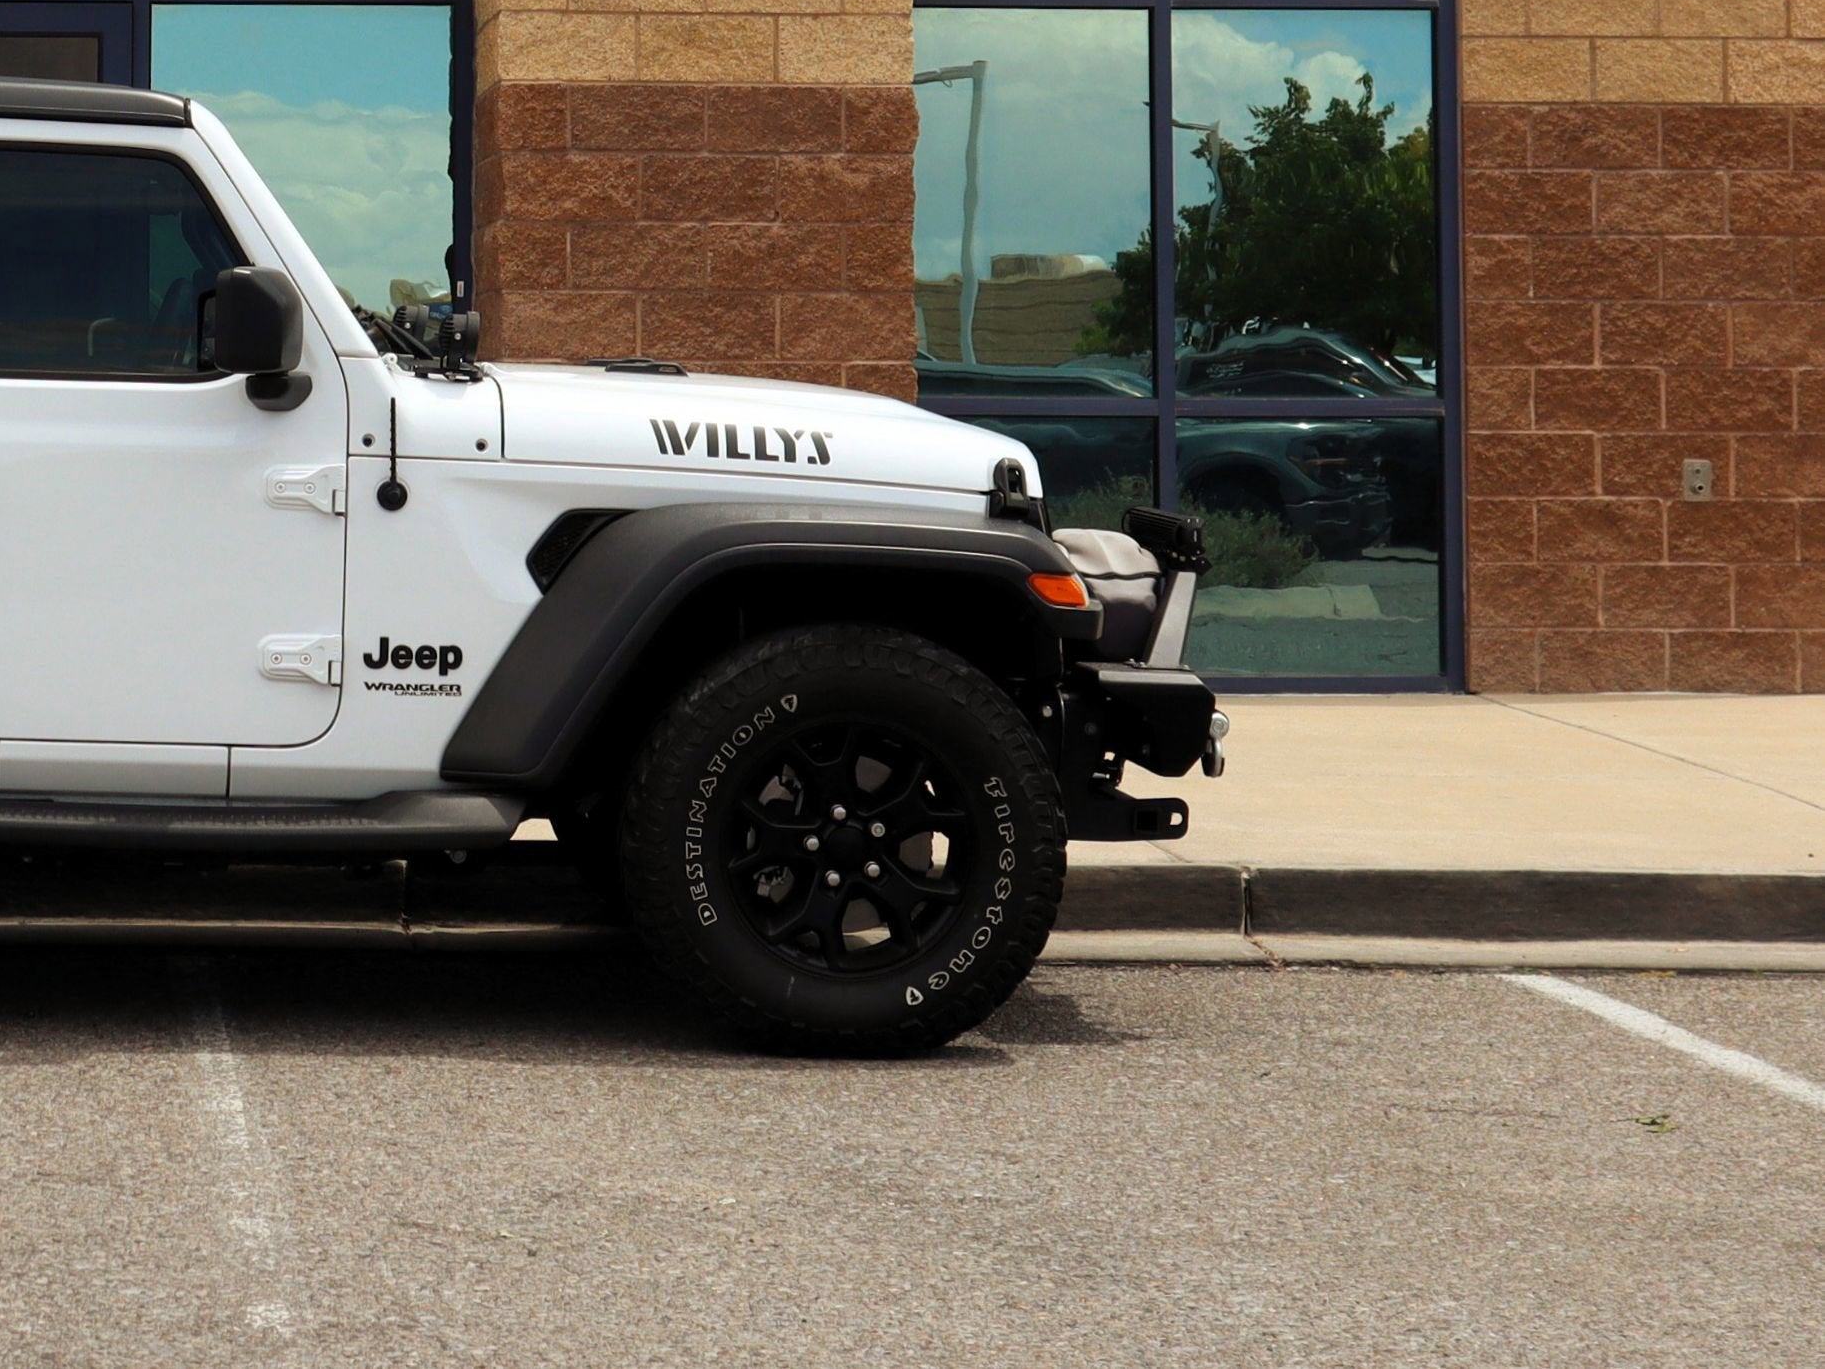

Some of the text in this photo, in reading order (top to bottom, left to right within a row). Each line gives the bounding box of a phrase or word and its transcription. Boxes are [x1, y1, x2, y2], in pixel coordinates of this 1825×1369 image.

[649, 418, 834, 466] WILLYS
[363, 636, 463, 676] Jeep
[364, 681, 461, 691] WRANGLER
[685, 706, 776, 926] DESTINATION
